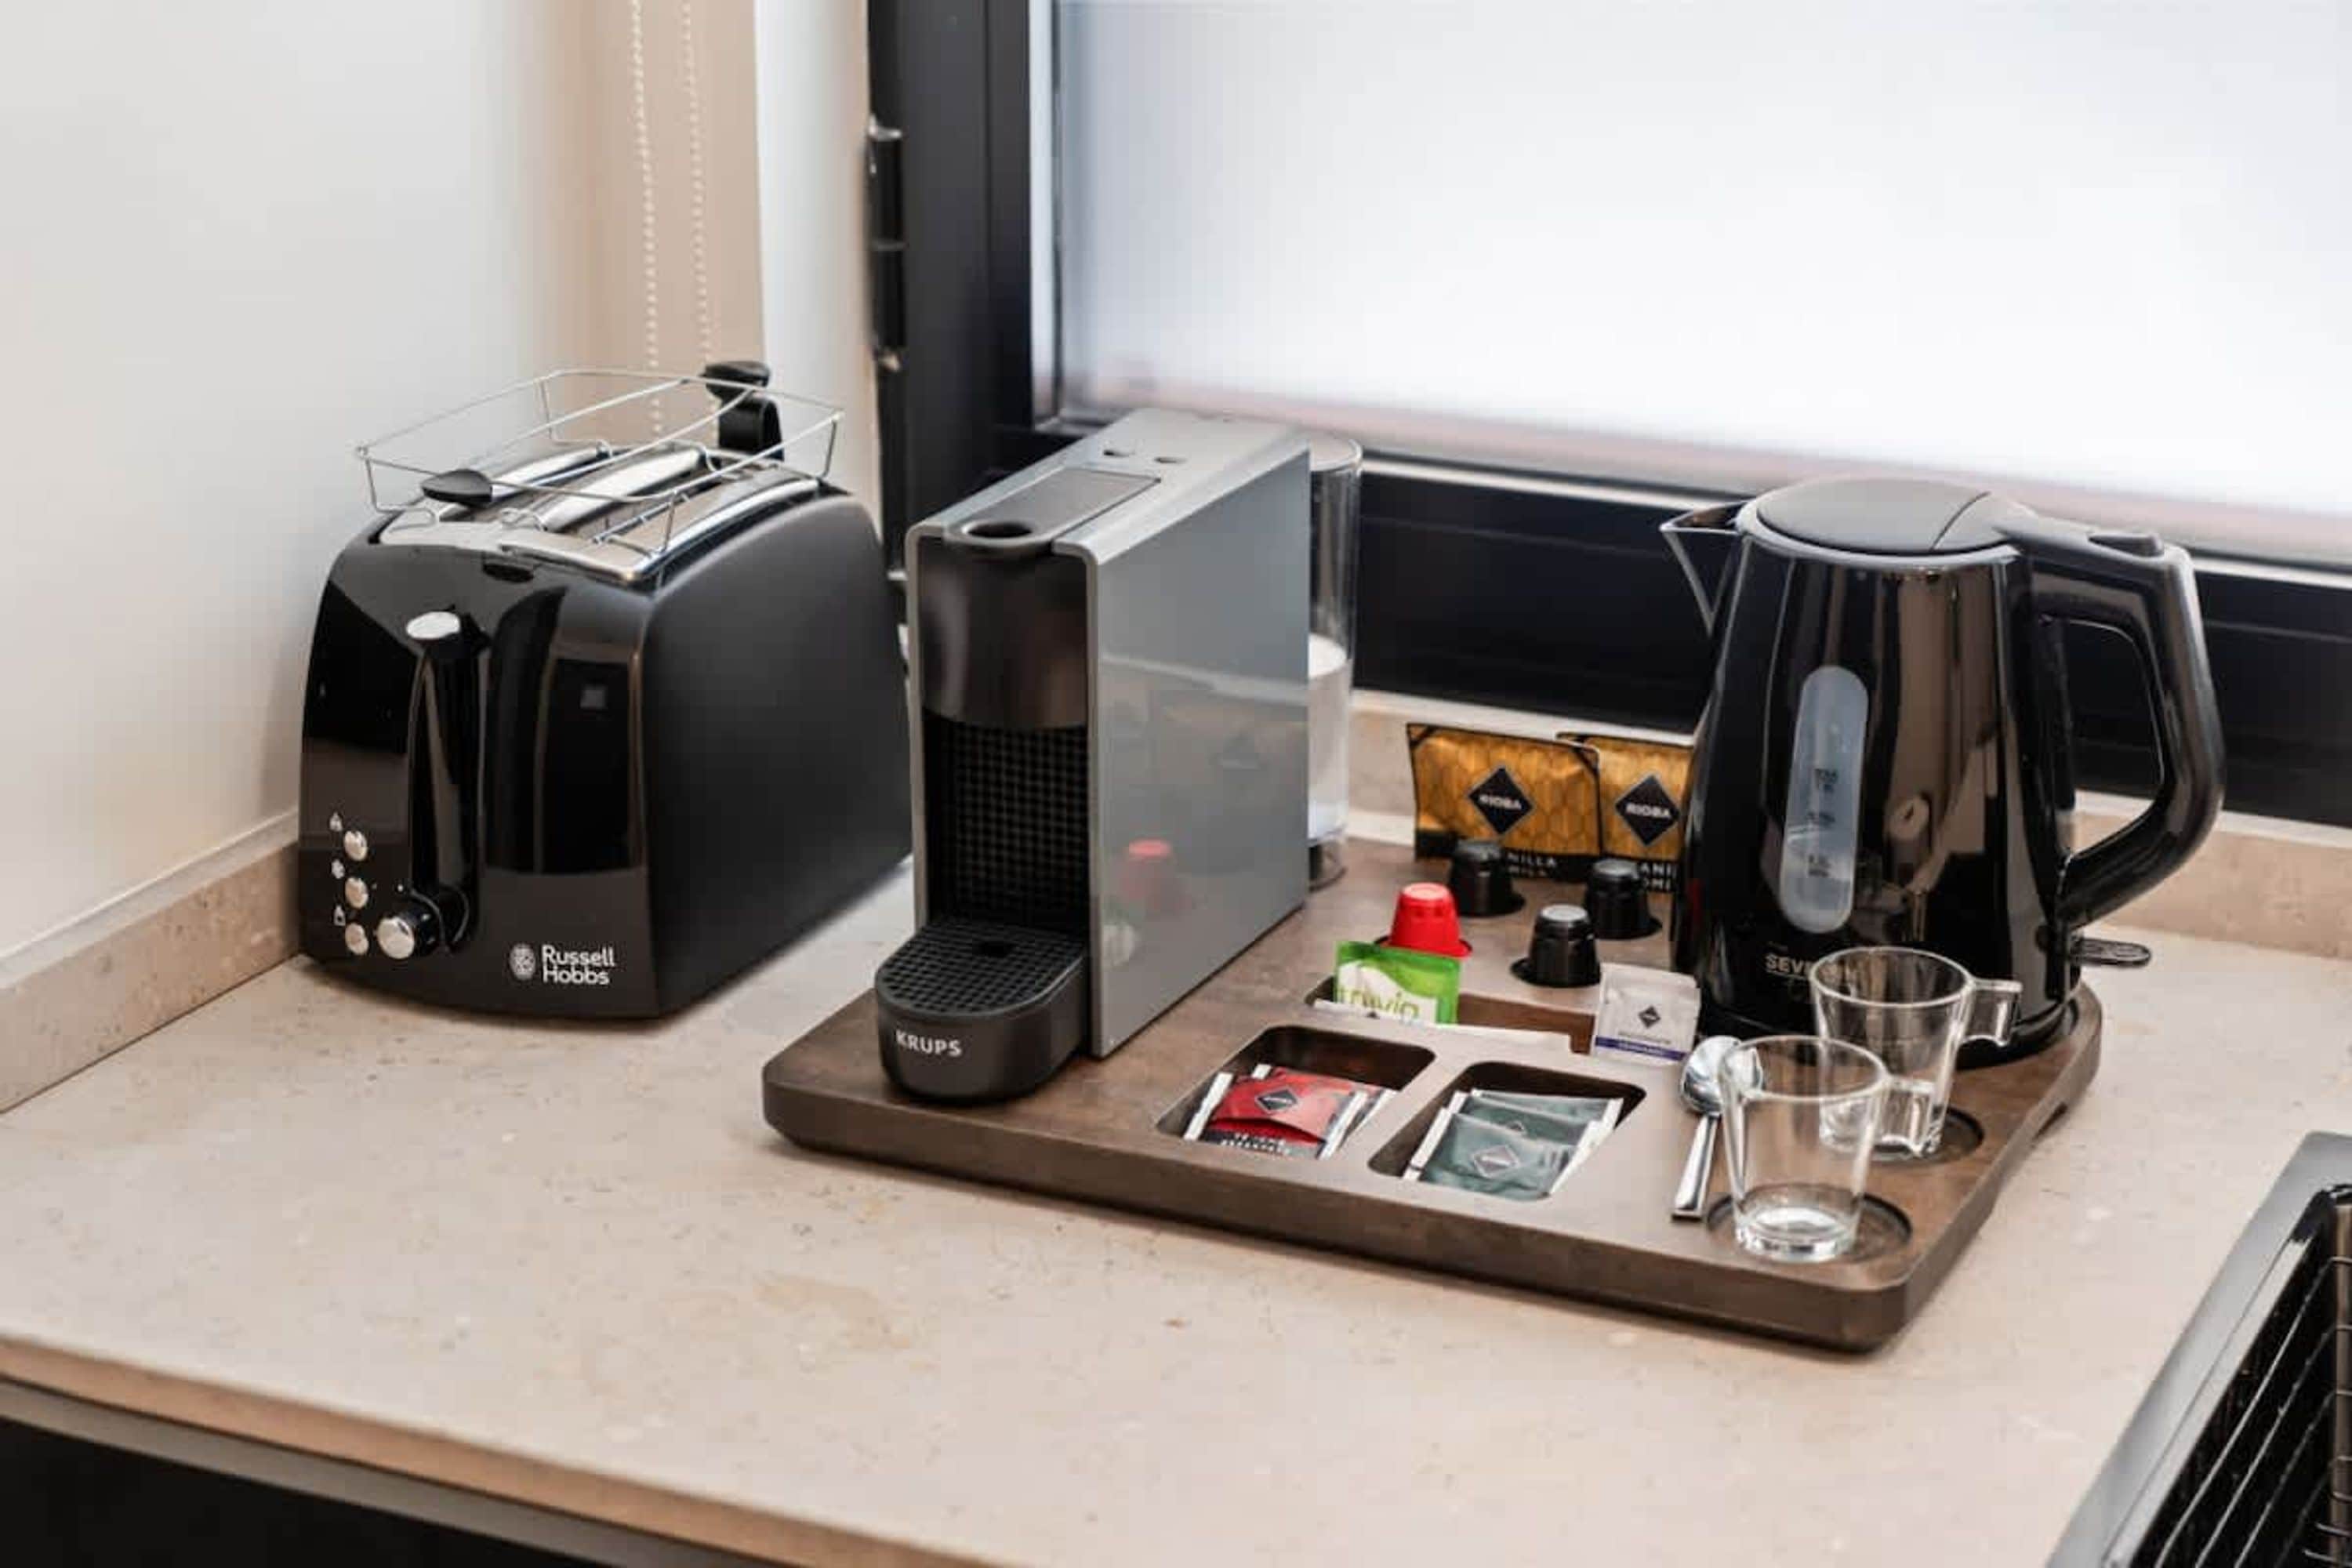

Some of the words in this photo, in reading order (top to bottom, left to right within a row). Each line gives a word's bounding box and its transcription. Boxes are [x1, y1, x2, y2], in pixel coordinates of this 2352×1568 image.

[1624, 802, 1671, 818] RIOBA
[541, 944, 615, 967] Russell
[542, 963, 610, 985] Hobbs
[895, 1029, 963, 1058] KRUPS
